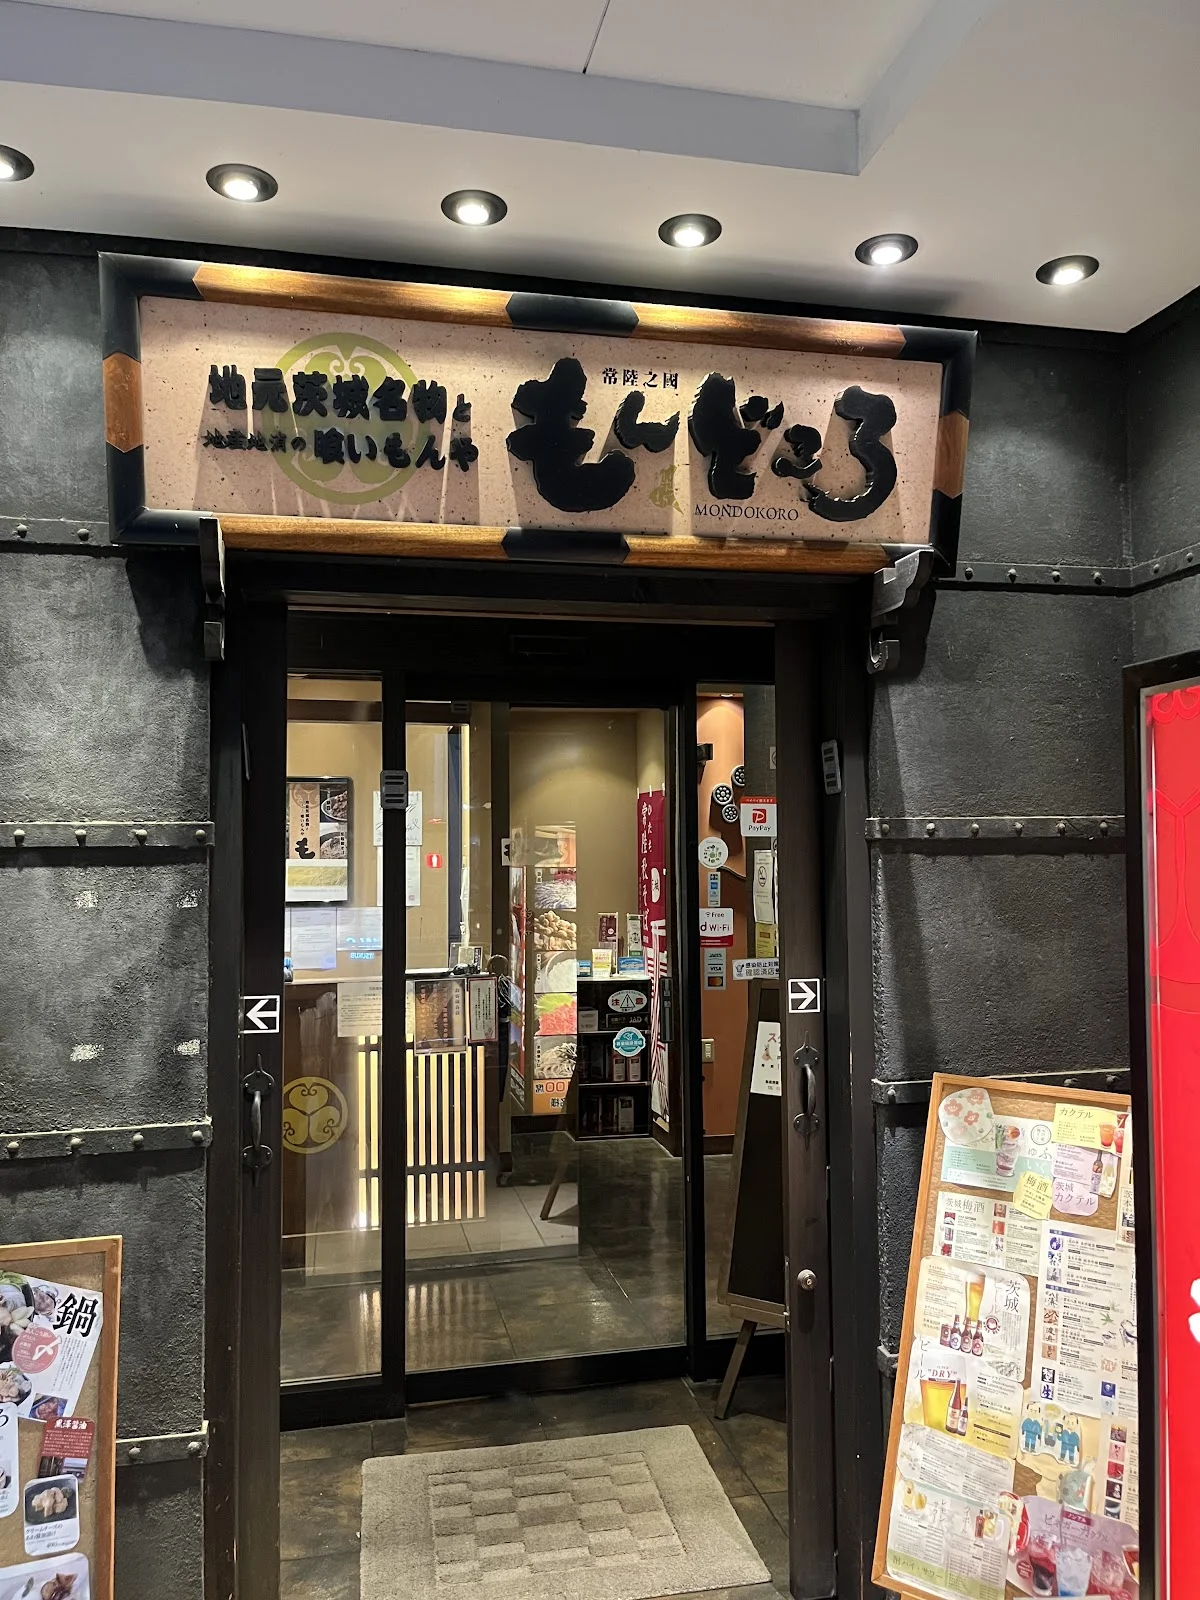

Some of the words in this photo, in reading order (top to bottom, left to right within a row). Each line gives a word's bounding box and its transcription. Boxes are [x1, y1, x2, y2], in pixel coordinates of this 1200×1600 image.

[602, 367, 680, 390] 常陸之國
[208, 364, 471, 424] 地元茨城名物と
[203, 426, 479, 473] 地産地消の喰いもんや
[496, 357, 899, 523] もんどころ
[694, 504, 799, 521] MONDOKORO
[709, 923, 730, 932] Wi-Fi
[1059, 1107, 1094, 1119] カクテル
[1025, 1174, 1050, 1193] 梅酒
[945, 1197, 986, 1214] 茨城梅酒
[1054, 1192, 1096, 1207] カクテル
[1003, 1279, 1021, 1313] 茨城
[53, 1292, 99, 1338] 鍋
[913, 1339, 931, 1379] ビール
